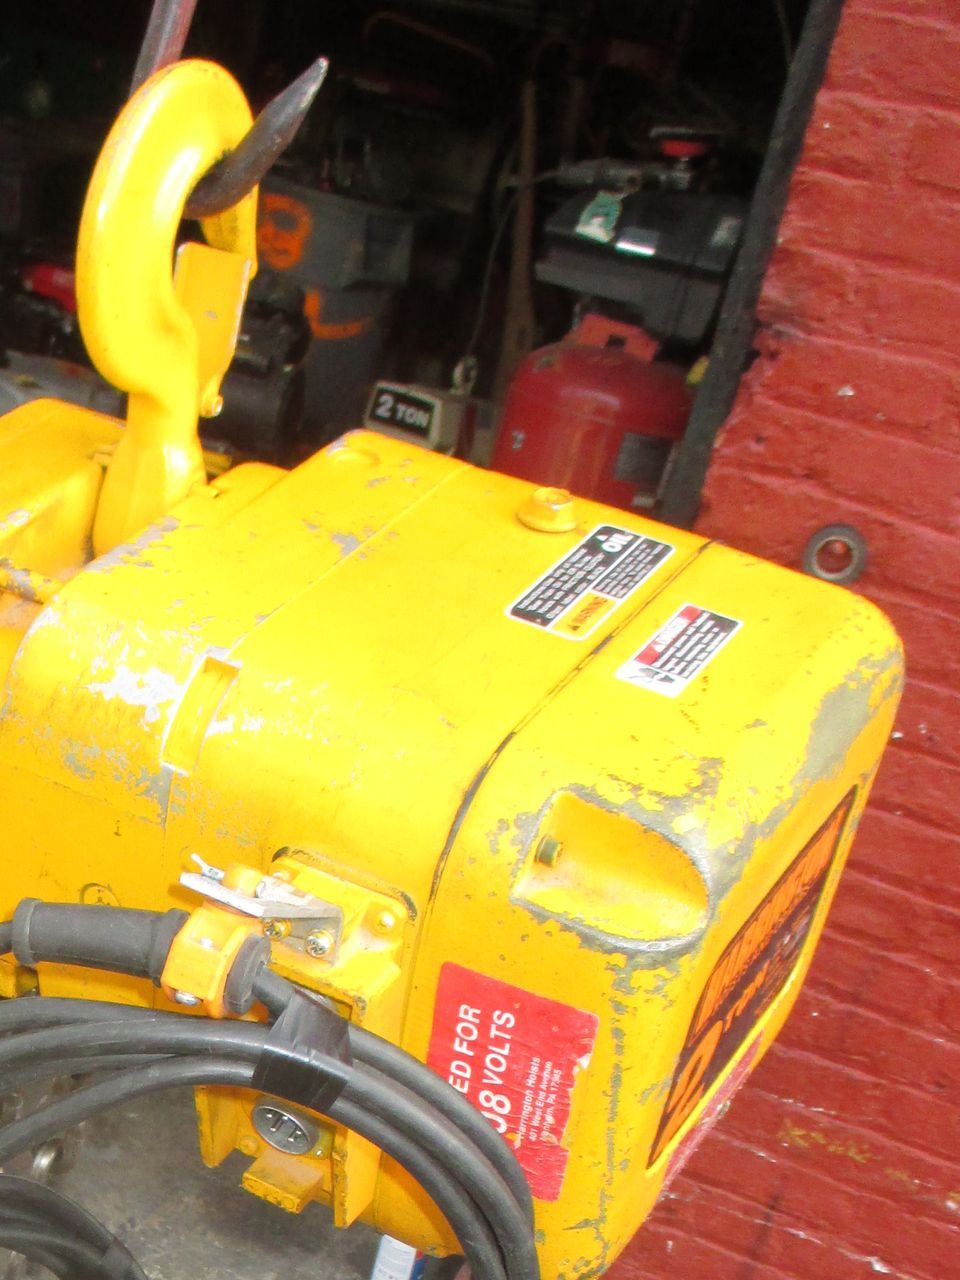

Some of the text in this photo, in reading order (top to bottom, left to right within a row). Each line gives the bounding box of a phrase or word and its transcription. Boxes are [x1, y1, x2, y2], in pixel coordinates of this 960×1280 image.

[375, 393, 431, 429] 2 TON
[601, 532, 635, 553] OIL
[449, 1003, 481, 1094] ED FOR
[482, 1009, 516, 1085] VOLTS
[515, 1056, 541, 1142] Harrington Hoists
